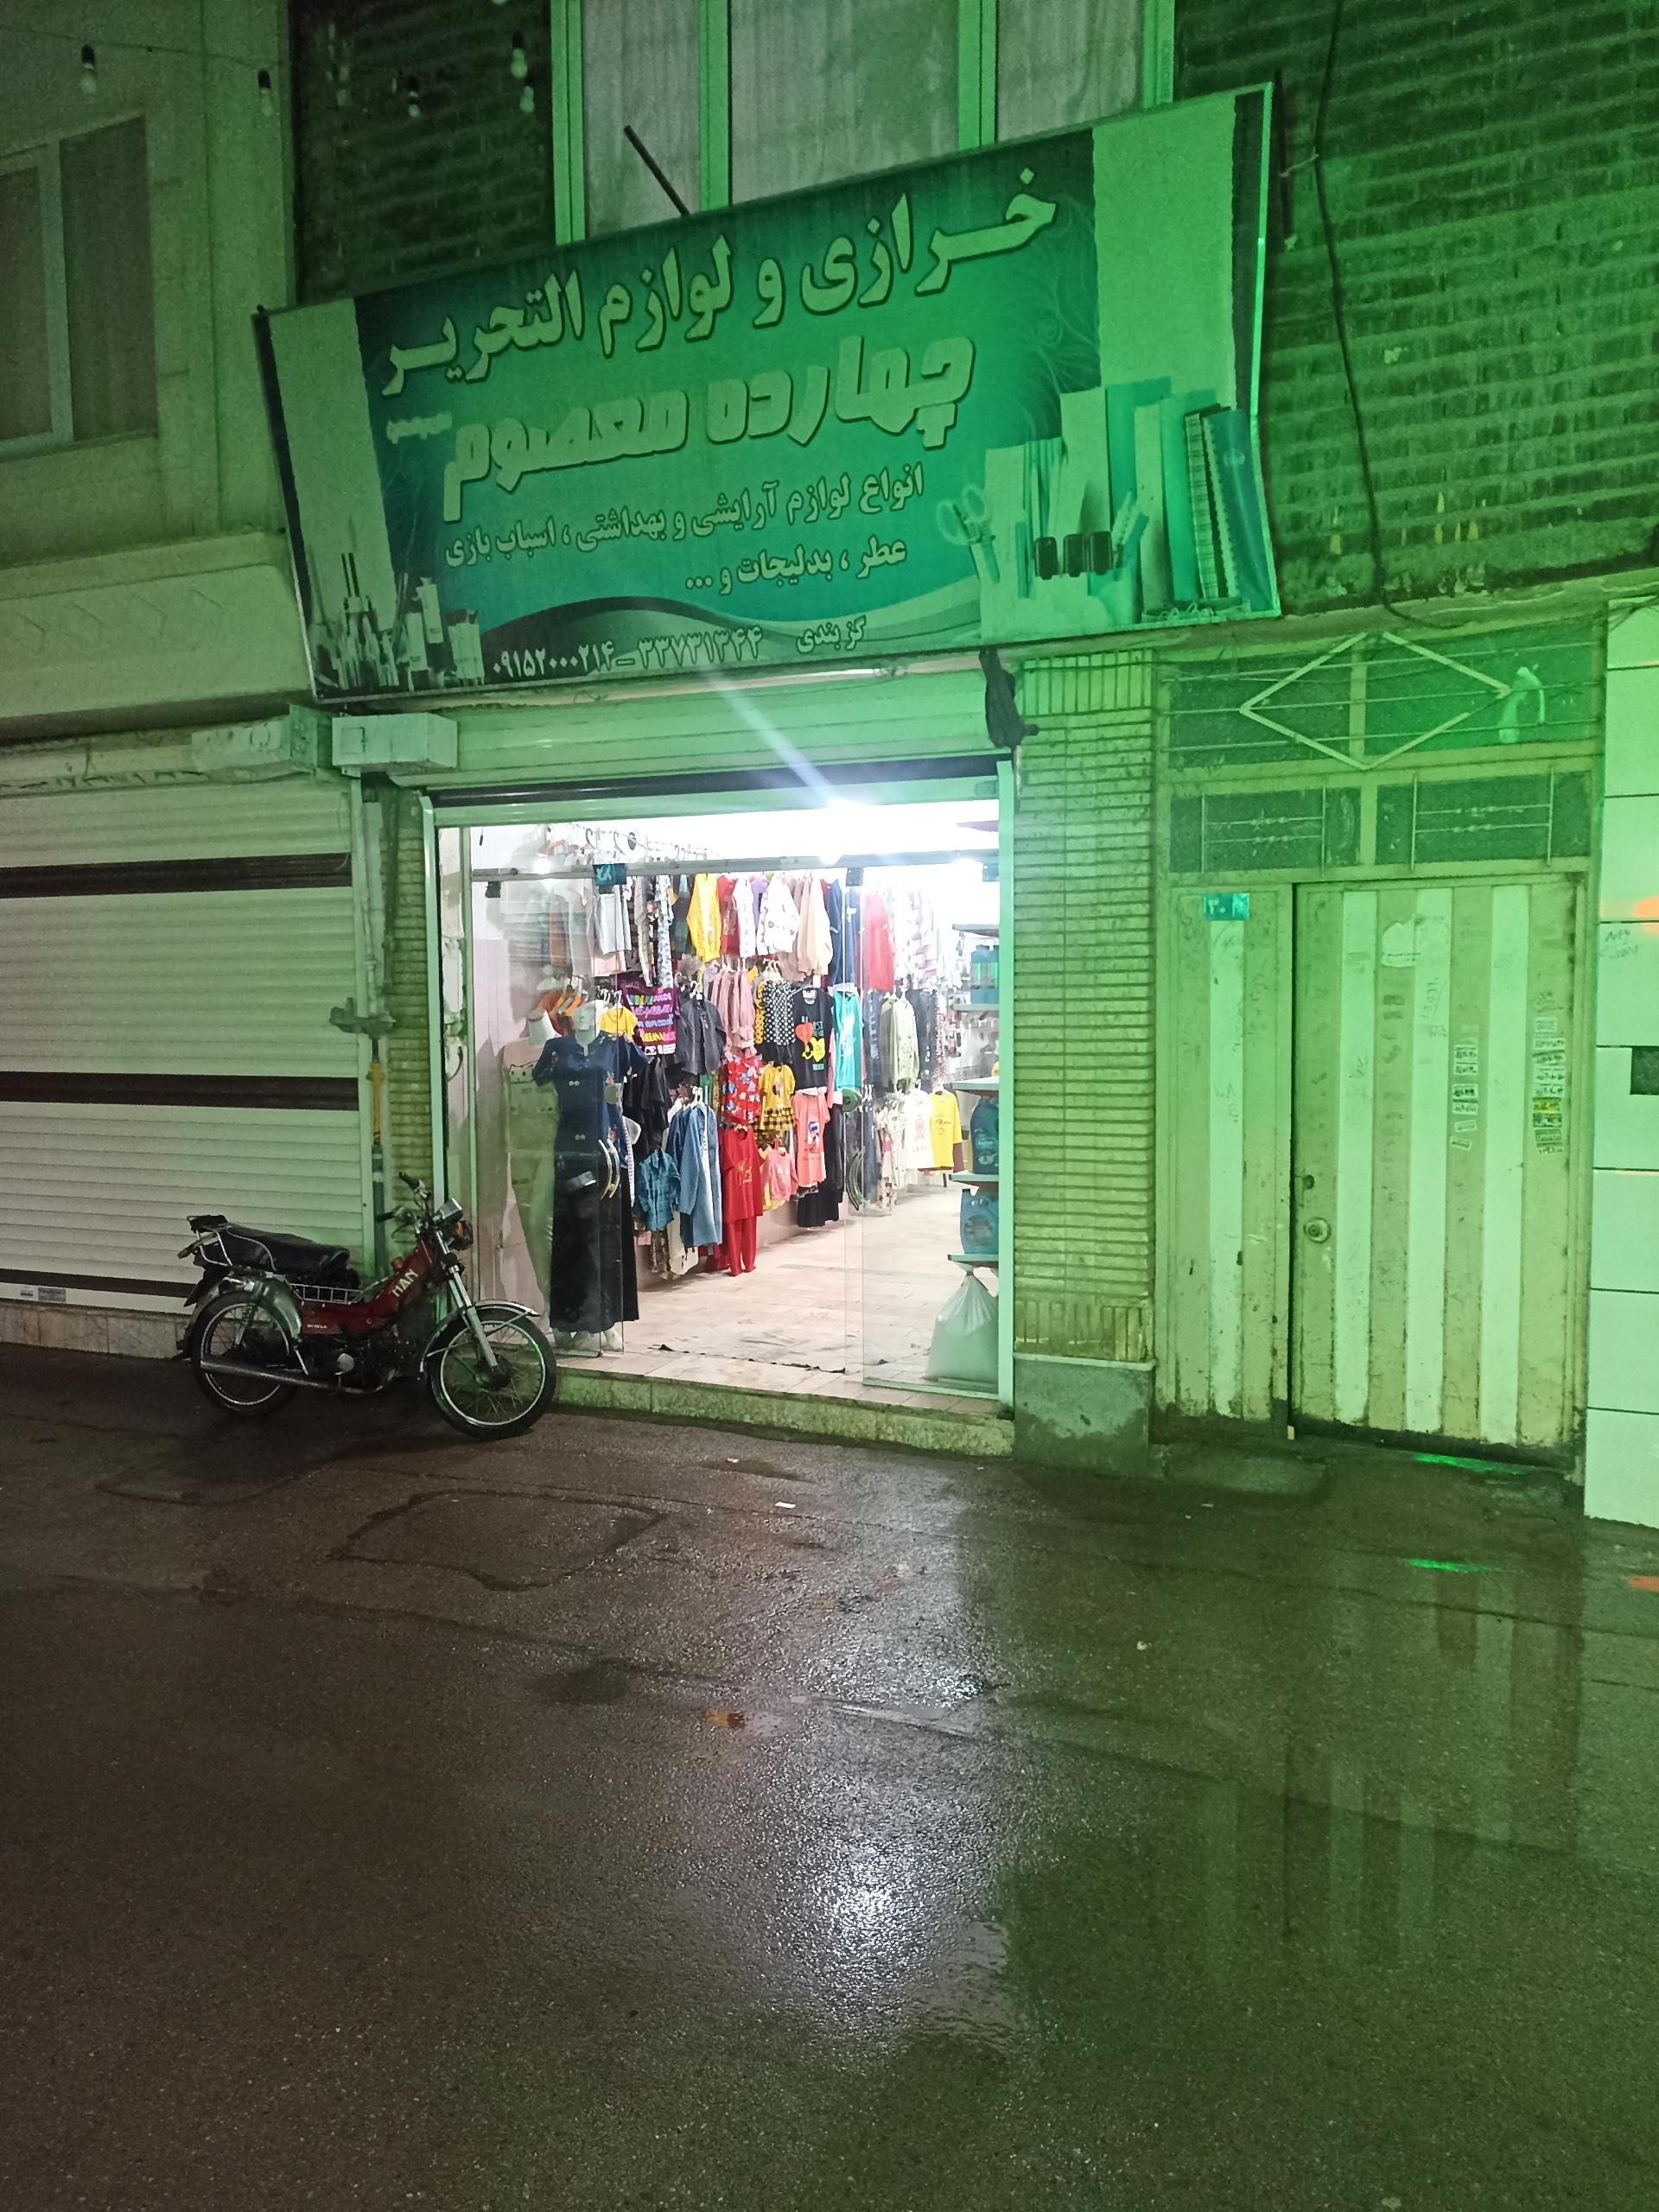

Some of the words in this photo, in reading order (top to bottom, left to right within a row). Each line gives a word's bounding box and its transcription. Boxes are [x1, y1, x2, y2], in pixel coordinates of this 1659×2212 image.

[800, 167, 1057, 316] خرازی
[598, 234, 732, 359] لوازم
[752, 258, 785, 329] و
[381, 269, 586, 397] التحریر
[707, 334, 976, 450] چهارده
[442, 389, 690, 524] معصوم
[690, 479, 779, 538] آرایشی
[786, 471, 852, 525] لوازم
[858, 461, 924, 513] انواع
[445, 524, 492, 568] بازی
[495, 514, 556, 560] اسباب
[575, 504, 667, 553] بهداشتی
[672, 511, 687, 541] و
[719, 567, 734, 595] و
[736, 543, 833, 588] بدلیجات
[855, 533, 908, 579] عطر
